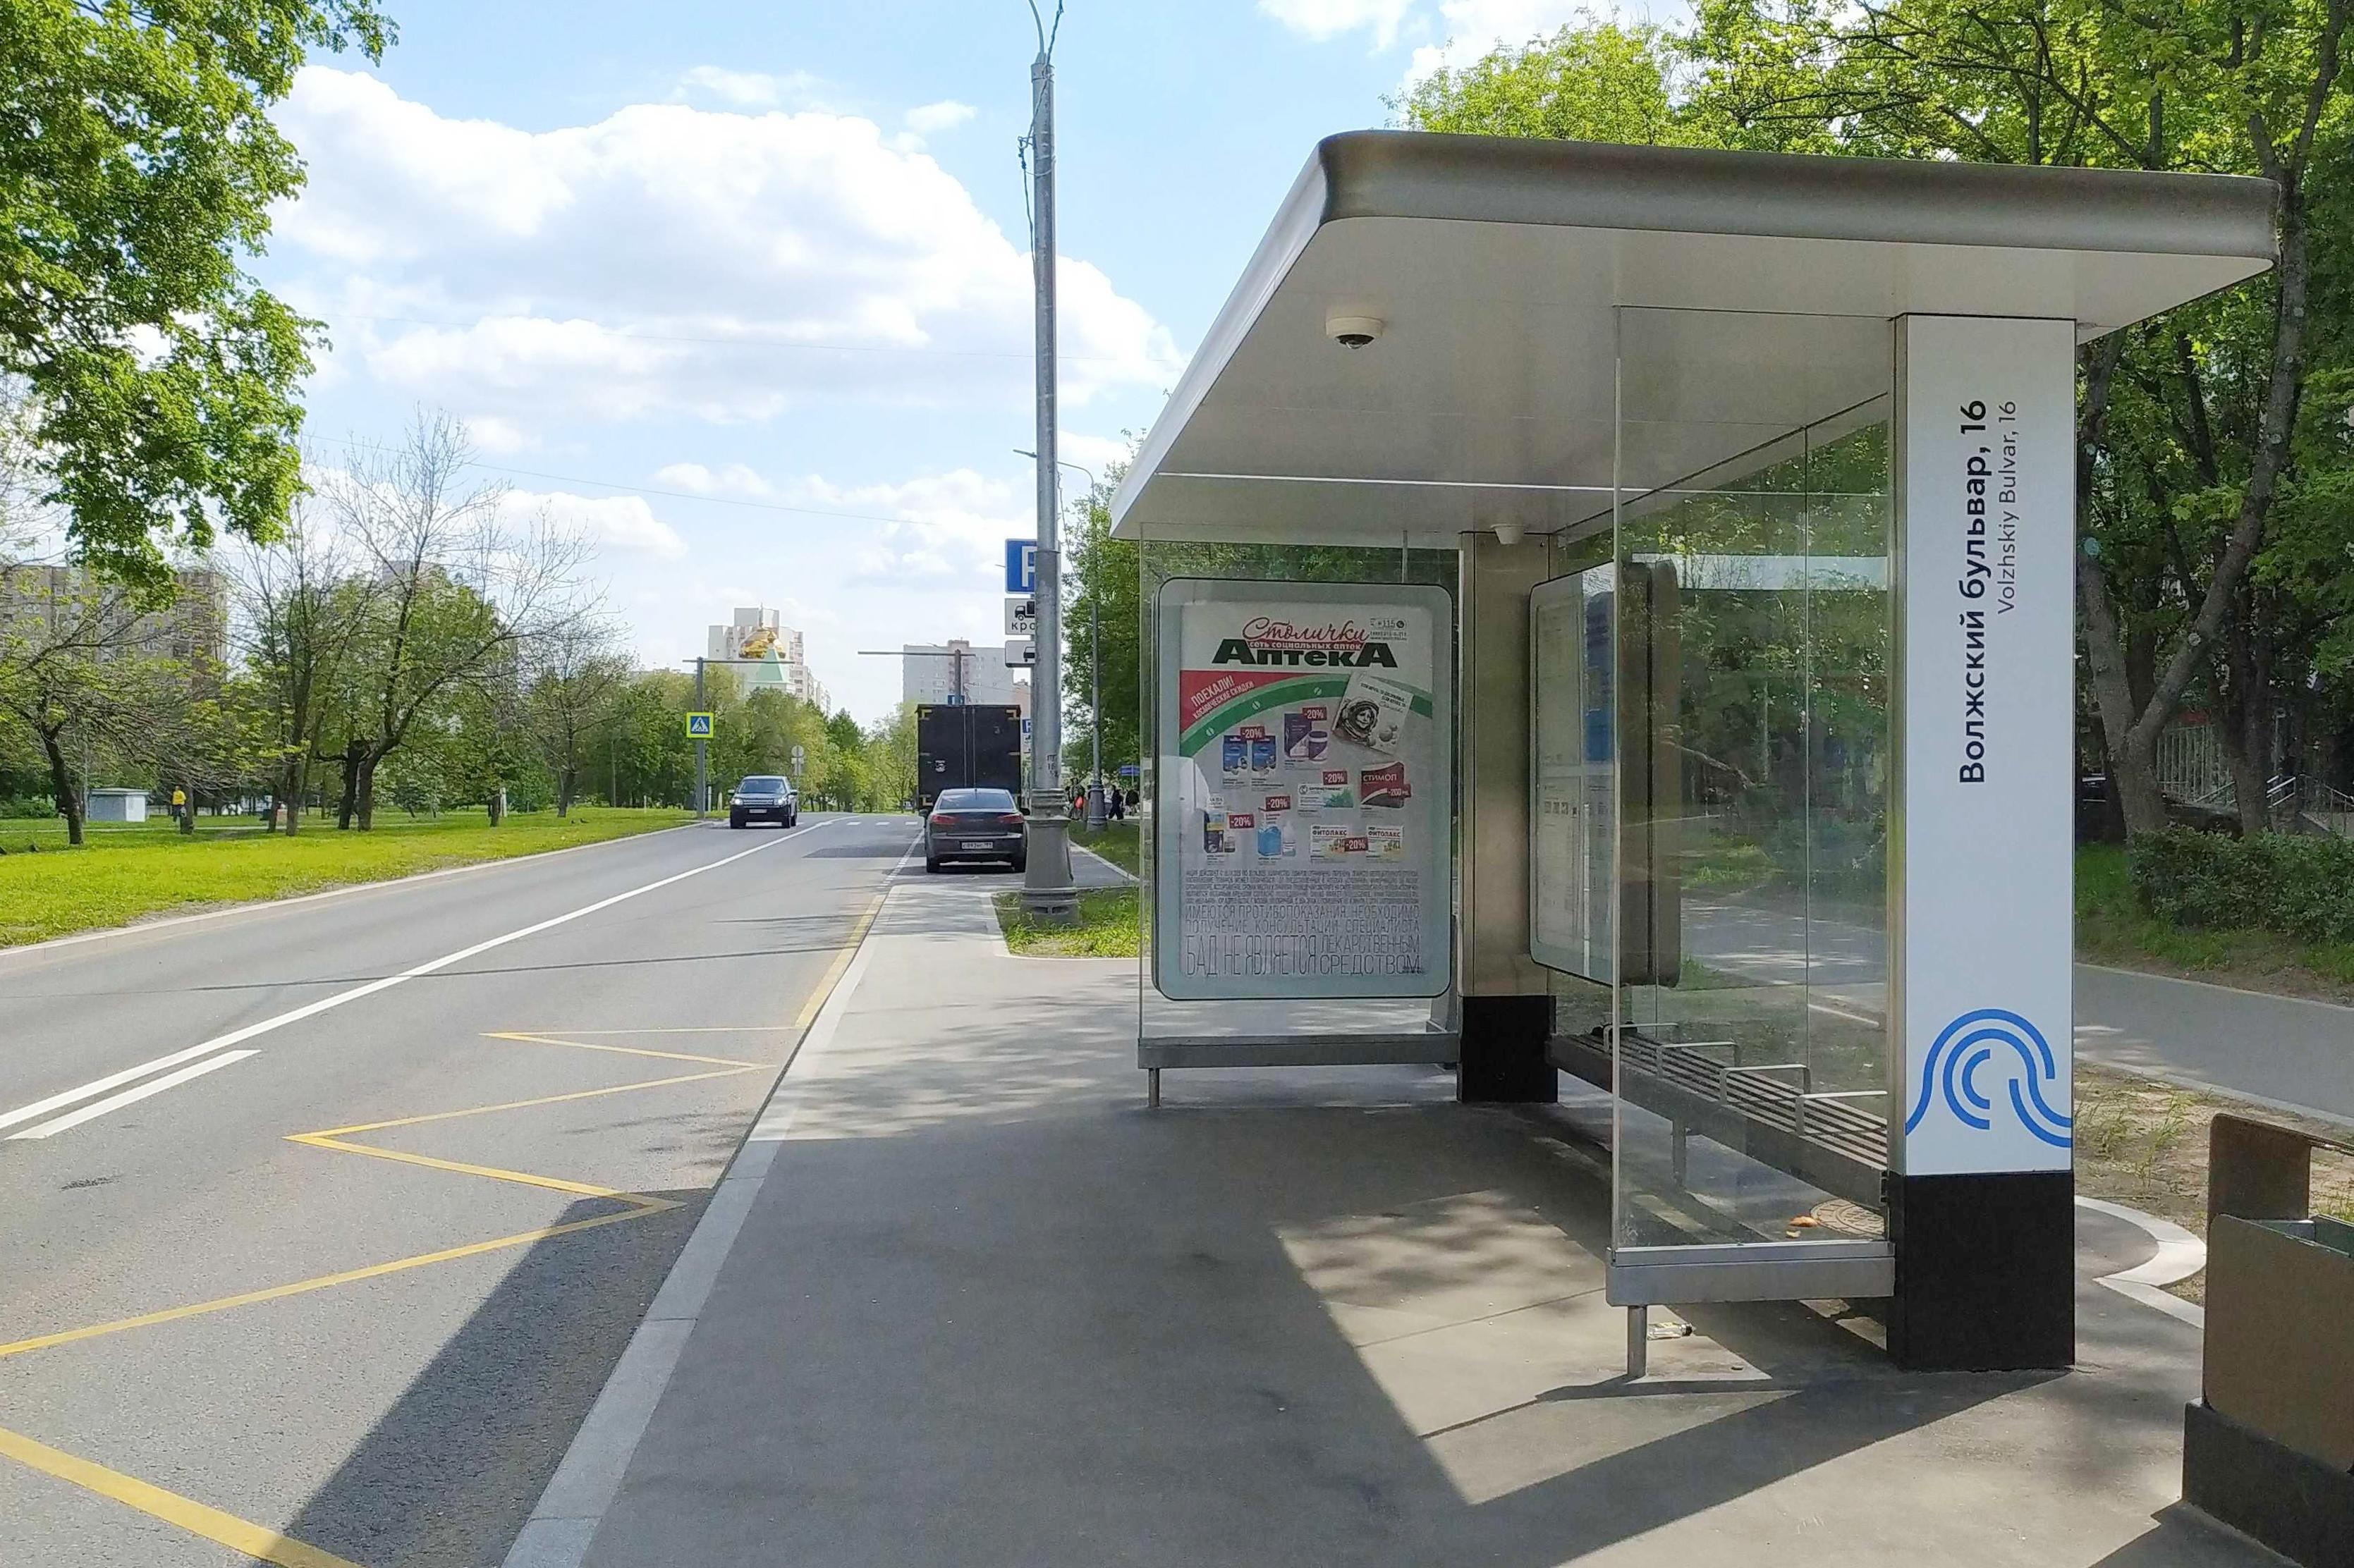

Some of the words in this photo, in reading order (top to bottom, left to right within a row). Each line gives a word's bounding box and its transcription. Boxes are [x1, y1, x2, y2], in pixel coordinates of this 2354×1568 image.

[1960, 400, 1986, 435] 16
[1999, 400, 2016, 424] 16
[1999, 431, 2018, 505] Bulvar,
[1958, 446, 1991, 599] бульвар,
[1997, 510, 2020, 613] Volzhskiy
[1242, 617, 1369, 641] Столички
[1190, 675, 1235, 707] ПОЕХАЛИ!
[1960, 611, 1985, 783] Волжский
[1304, 709, 1324, 720] -20%
[1242, 728, 1263, 738] -20%
[1324, 773, 1344, 783] -20%
[1267, 798, 1288, 809] -20%
[1231, 816, 1251, 826] -20%
[1346, 840, 1366, 850] -20%
[1185, 905, 1236, 919] ИМЕЮТСЯ
[1353, 905, 1420, 919] НЕОБХОДИМО
[1186, 919, 1248, 933] ПОЛУЧЕНИЕ
[1255, 919, 1338, 934] КОНСУЛЬТАЦИИ
[1346, 919, 1420, 934] СПЕЦИАЛИСТА
[1321, 934, 1420, 953] ЛЕКАРСТВЕННЫМ
[1187, 935, 1218, 976] БАД
[1224, 935, 1241, 975] НЕ
[1245, 935, 1316, 975] ЯВЛЯЕТСЯ
